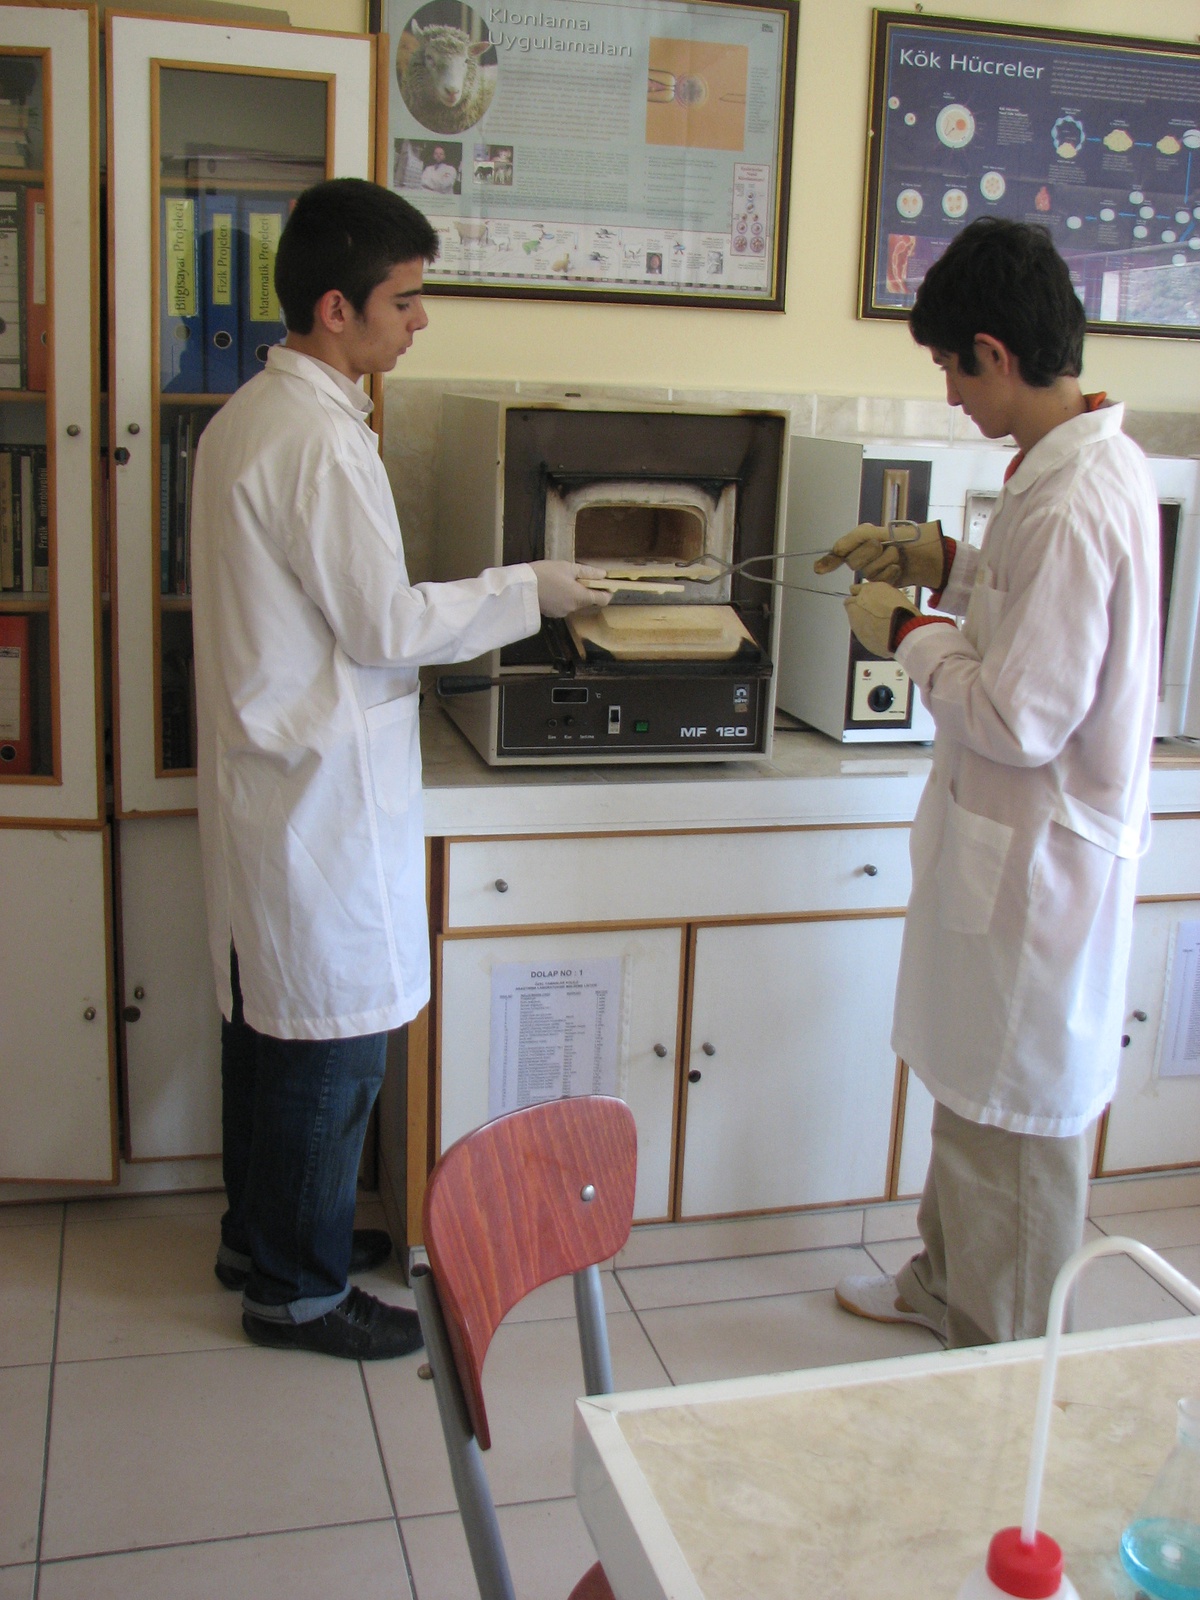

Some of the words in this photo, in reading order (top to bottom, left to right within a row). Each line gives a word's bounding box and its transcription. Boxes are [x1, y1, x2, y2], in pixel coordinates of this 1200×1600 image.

[489, 8, 590, 31] Klonlama
[488, 30, 632, 57] Uygulamaları
[900, 48, 941, 69] Kök
[950, 53, 1044, 79] Hücreler
[172, 203, 187, 252] Projeleri
[258, 218, 272, 260] Projeleri
[217, 224, 231, 267] Projeleri
[174, 256, 190, 311] Bilgisayar
[217, 270, 228, 294] Fizik
[258, 262, 269, 316] Matematik
[680, 727, 707, 737] MF
[715, 726, 748, 737] 120
[530, 970, 559, 978] DOLAP
